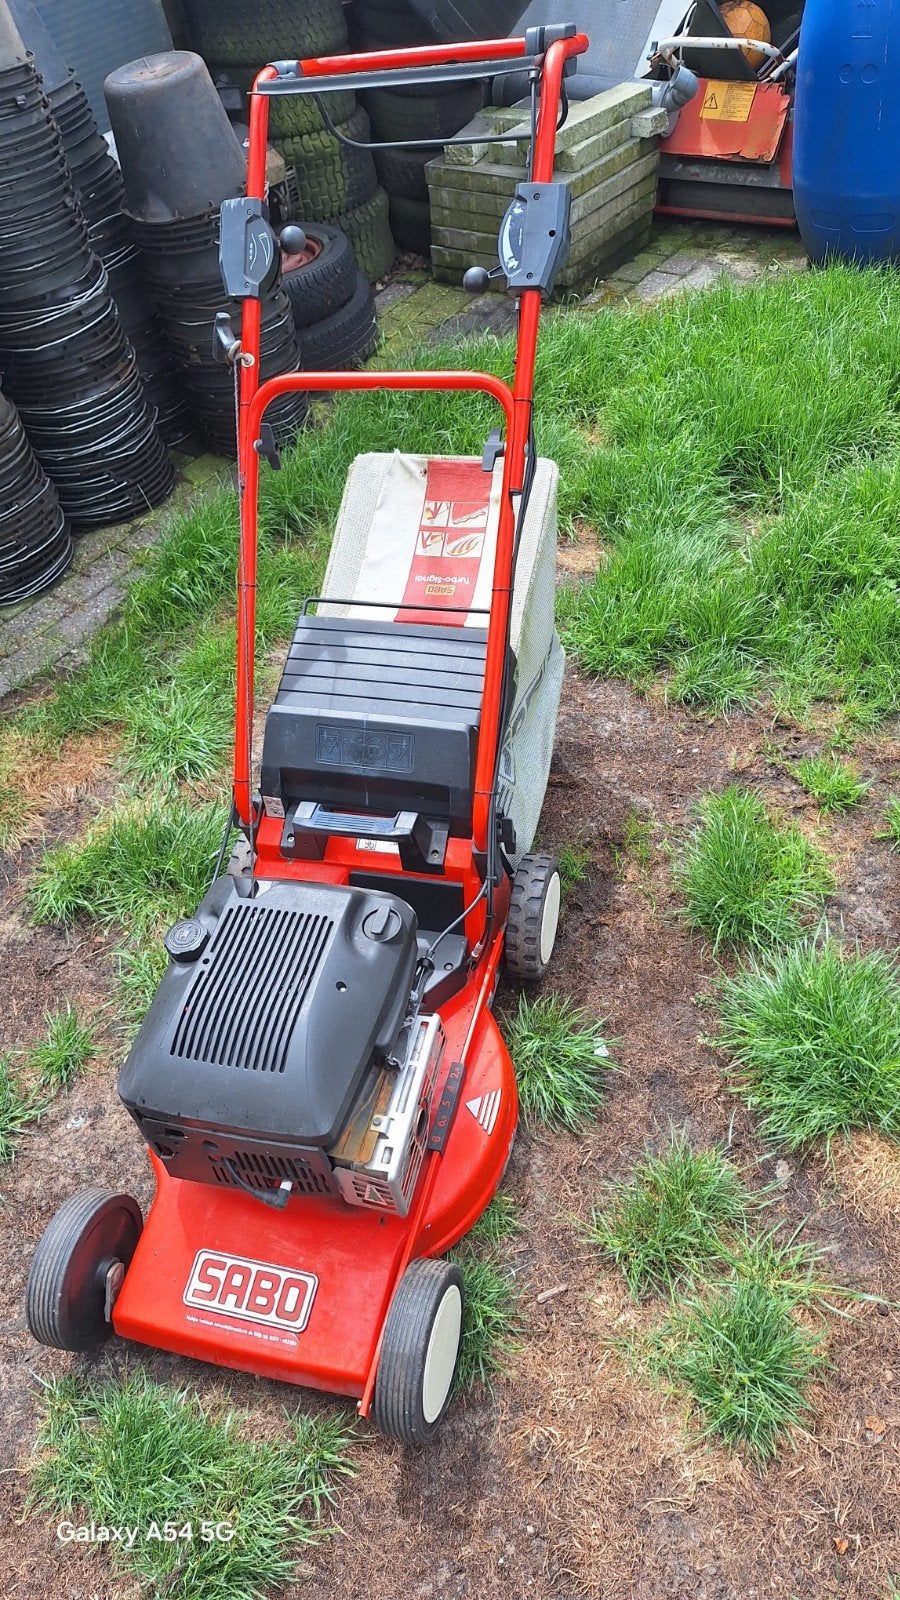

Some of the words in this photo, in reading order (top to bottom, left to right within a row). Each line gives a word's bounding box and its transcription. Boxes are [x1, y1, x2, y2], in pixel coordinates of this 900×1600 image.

[415, 575, 471, 584] Turbo-Signal
[428, 585, 453, 593] SABO
[192, 1259, 308, 1322] SABO
